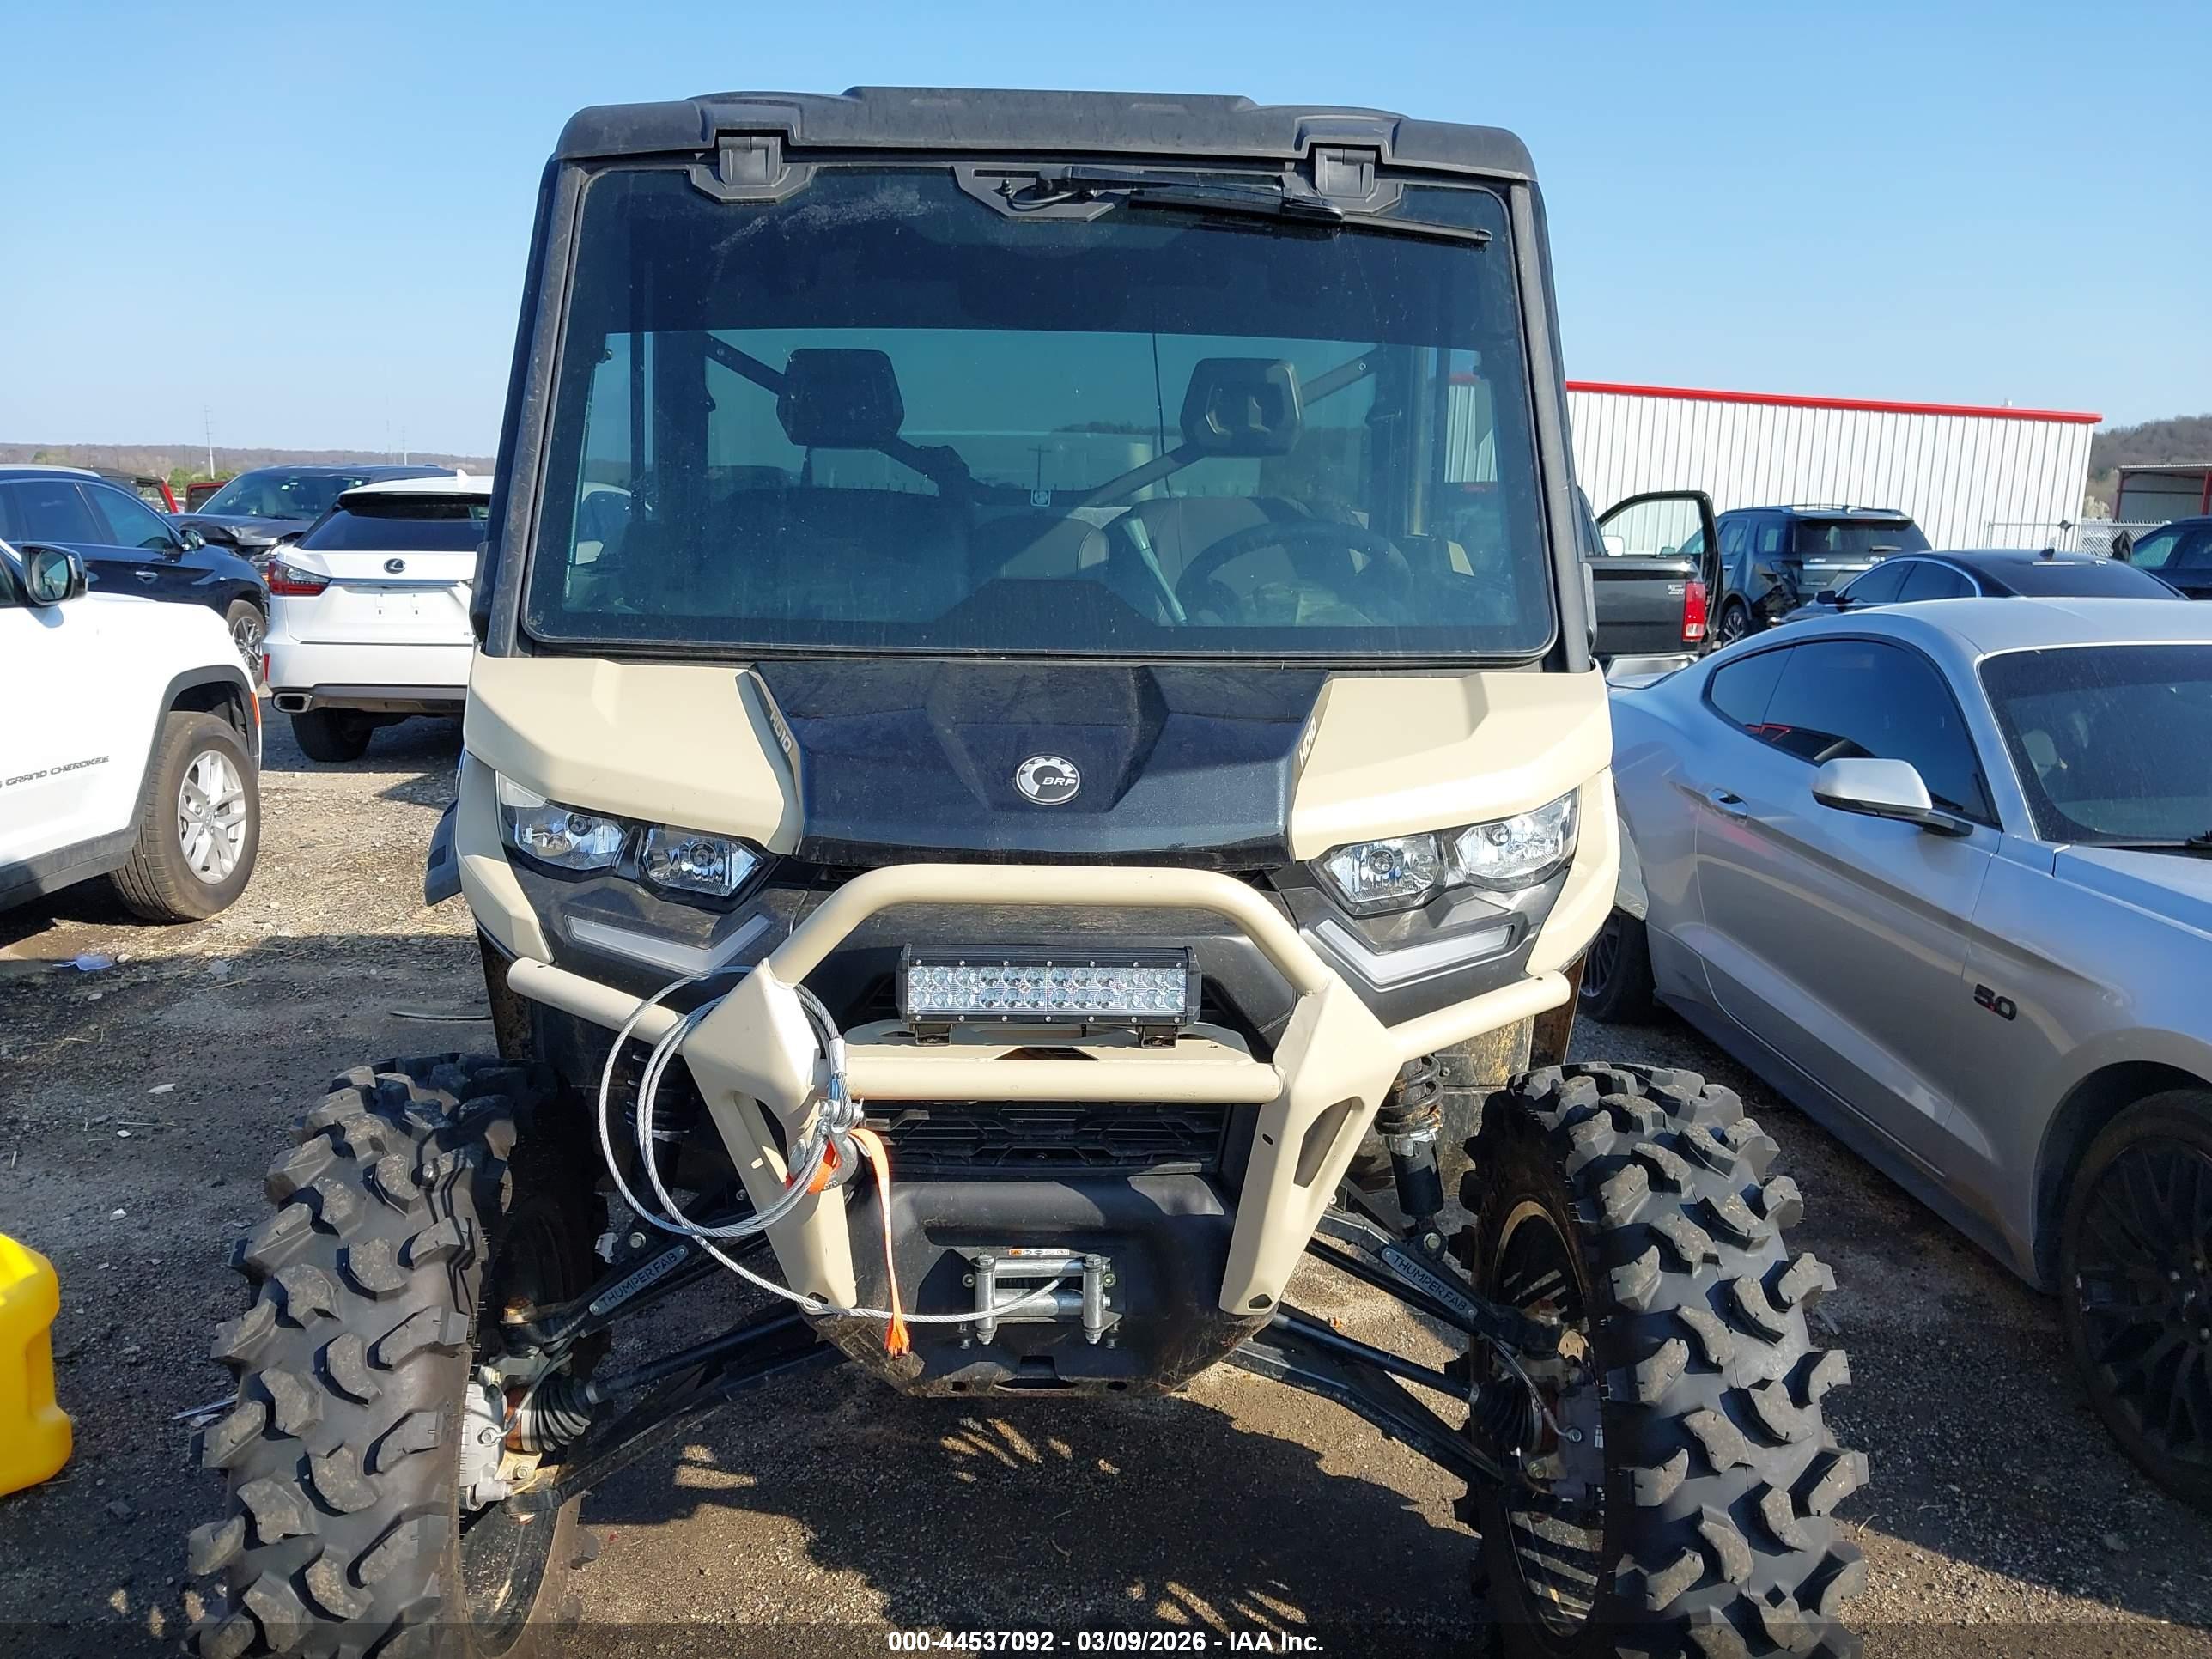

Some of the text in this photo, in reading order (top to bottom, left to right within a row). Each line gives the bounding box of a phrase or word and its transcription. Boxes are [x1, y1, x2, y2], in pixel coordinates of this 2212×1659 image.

[1298, 716, 1316, 768] HD10
[5, 769, 47, 786] GRAND
[50, 756, 109, 775] CHEROKEE
[1042, 776, 1077, 787] BRP
[599, 1253, 678, 1306] THUMPER FAB
[1393, 1255, 1468, 1310] THUMPER FAB
